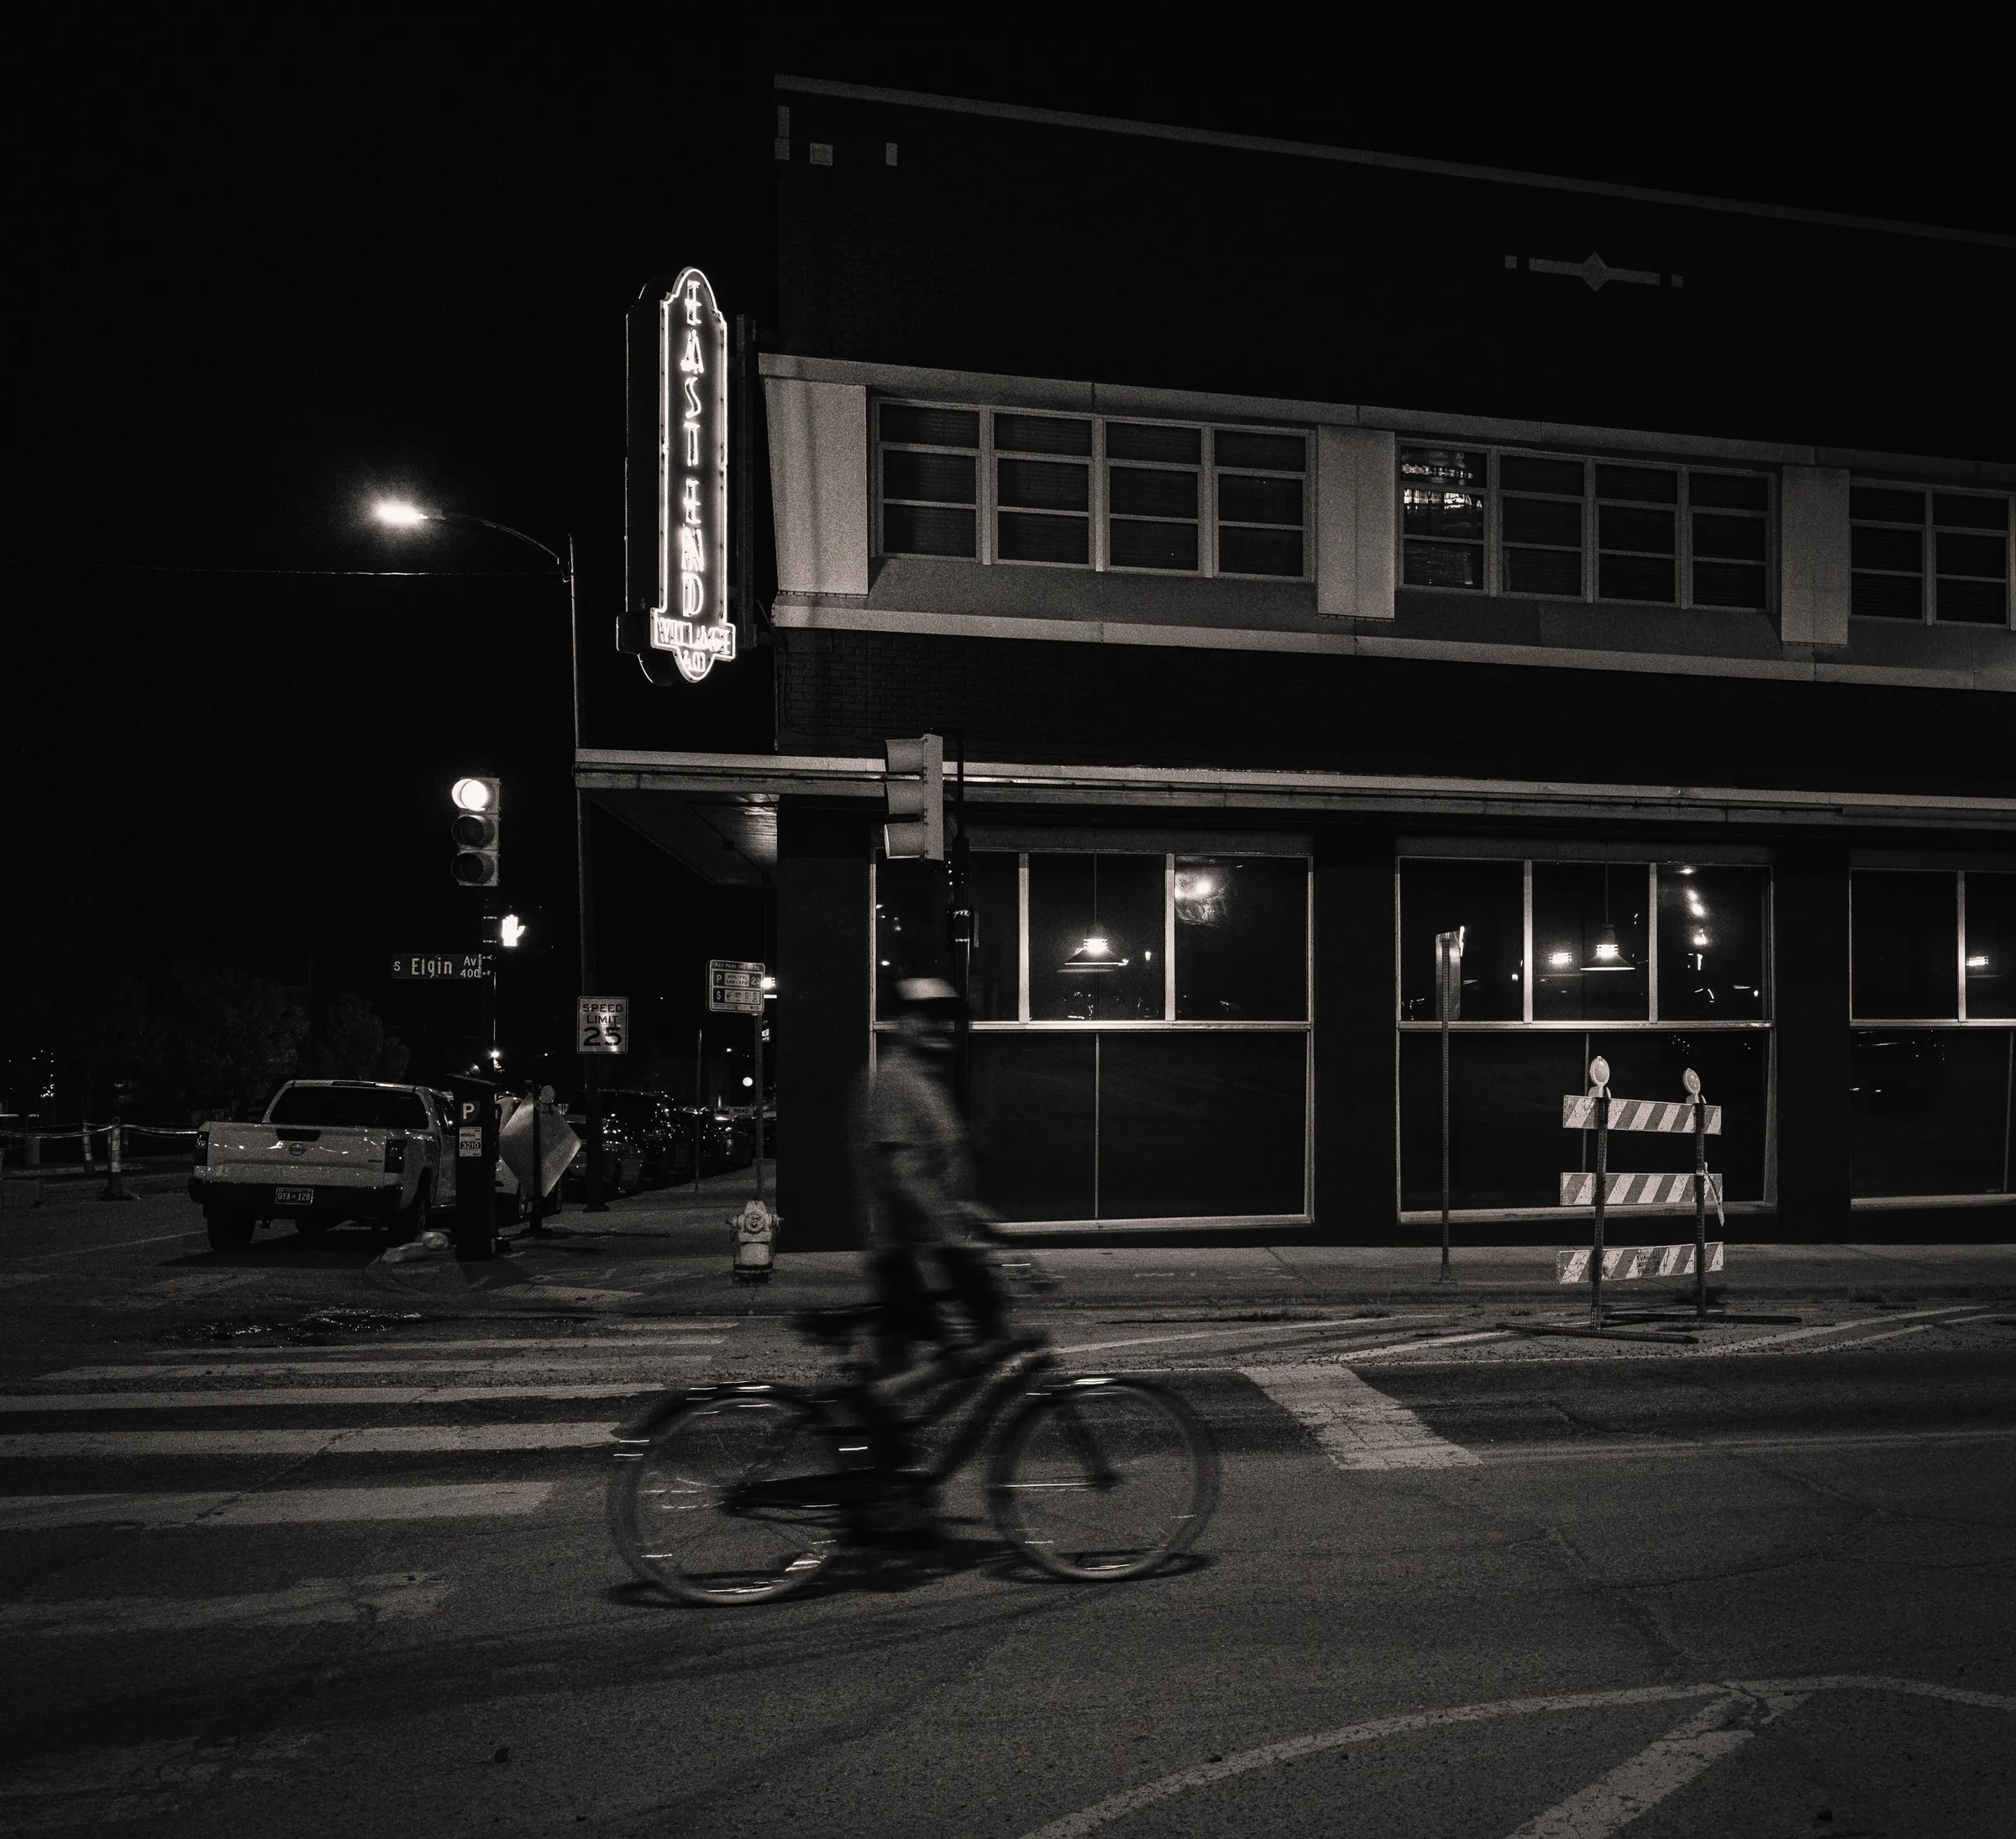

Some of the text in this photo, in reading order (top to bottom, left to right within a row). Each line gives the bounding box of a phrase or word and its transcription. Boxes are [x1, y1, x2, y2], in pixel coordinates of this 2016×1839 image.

[680, 280, 704, 617] EAST END
[412, 956, 452, 978] Elgin
[463, 956, 476, 966] Av
[717, 975, 722, 983] P
[582, 1004, 623, 1012] SPEED
[586, 1015, 618, 1023] LIMIT
[583, 1027, 622, 1047] 25
[463, 1102, 475, 1120] P
